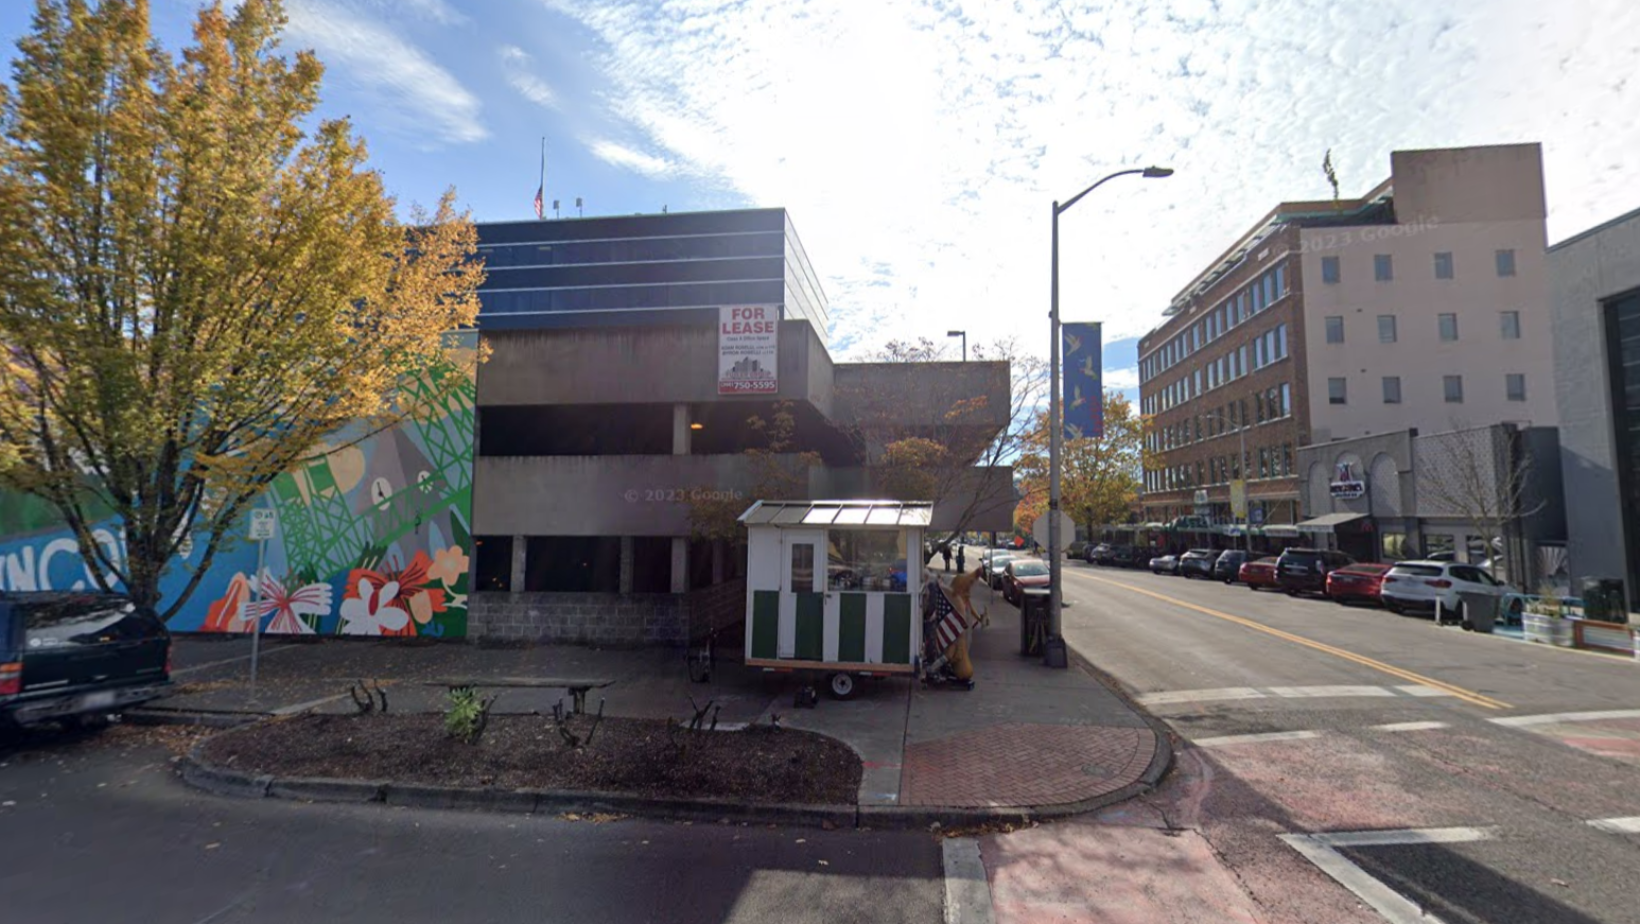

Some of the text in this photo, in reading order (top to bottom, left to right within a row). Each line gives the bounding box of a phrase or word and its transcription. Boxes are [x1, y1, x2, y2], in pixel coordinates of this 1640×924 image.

[731, 307, 765, 320] FOR
[722, 321, 774, 335] LEASE
[734, 381, 775, 389] 750-5595
